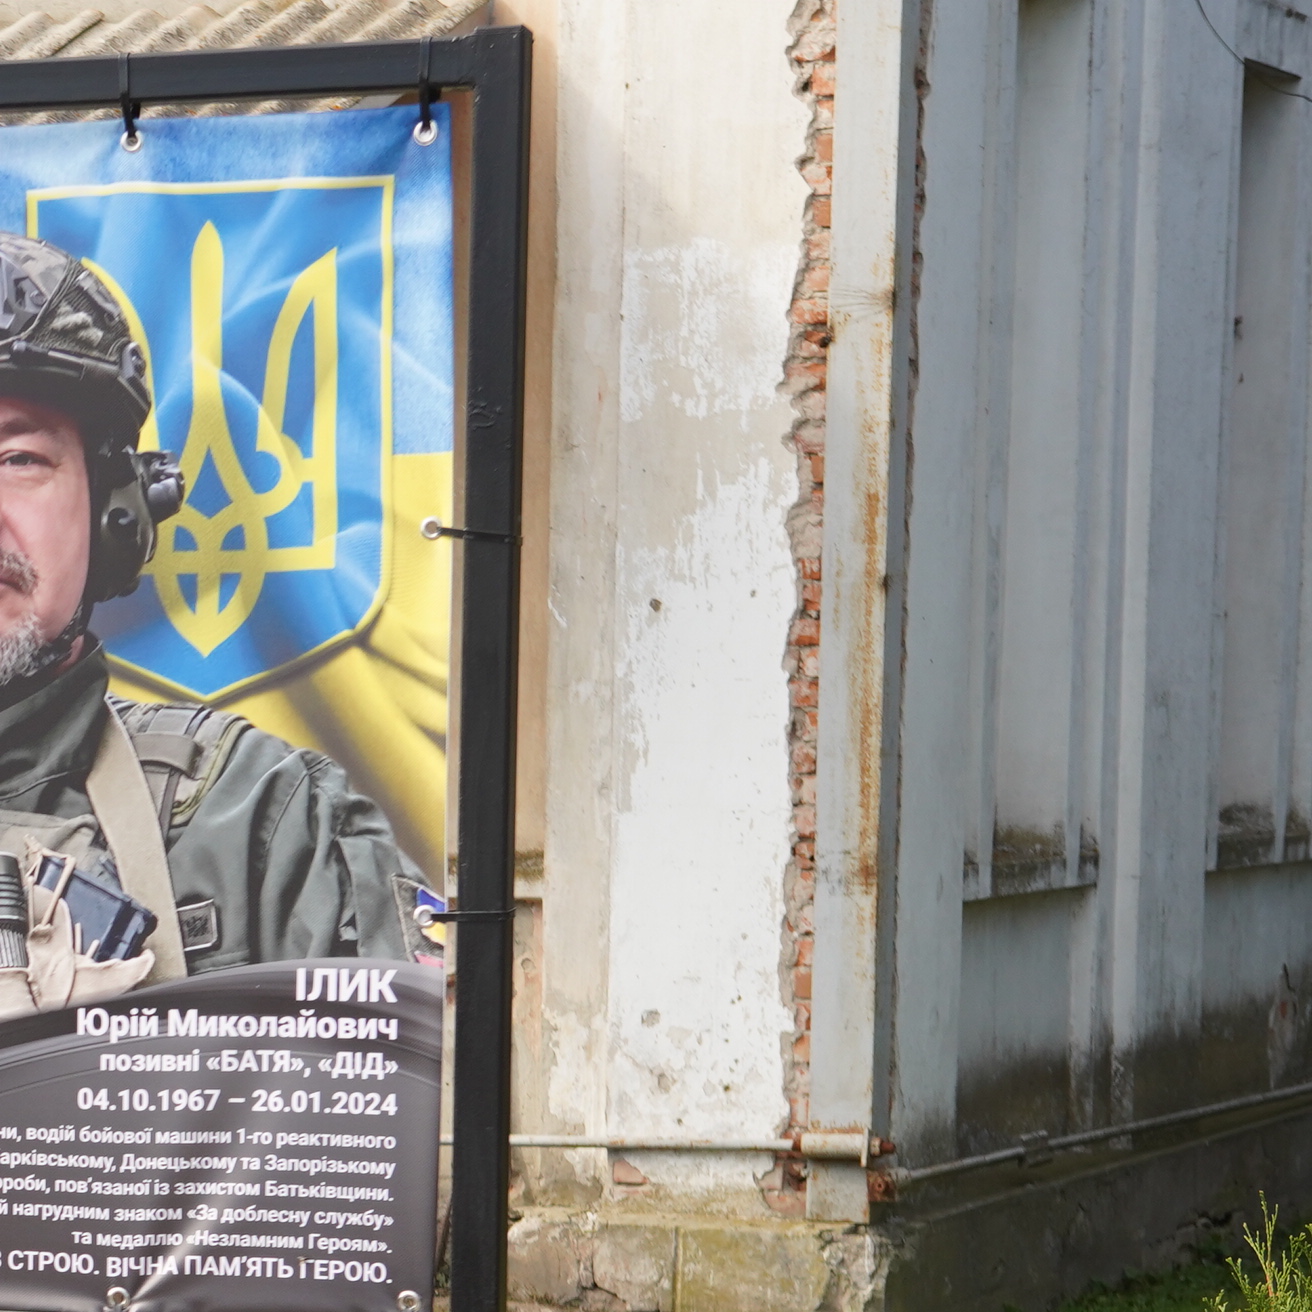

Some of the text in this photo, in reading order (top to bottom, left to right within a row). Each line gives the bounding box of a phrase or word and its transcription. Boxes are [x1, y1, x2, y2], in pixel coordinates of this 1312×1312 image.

[295, 967, 399, 1003] ІЛИК
[76, 1007, 398, 1043] Юрій Миколайович
[99, 1049, 399, 1080] позивні «БАТЯ», «ДІД»
[76, 1087, 221, 1112] 04.10.1967
[251, 1090, 398, 1115] 26.01.2024
[25, 1124, 76, 1143] водій
[78, 1126, 153, 1145] бойової
[154, 1131, 232, 1145] машини
[236, 1128, 273, 1147] 1-го
[275, 1132, 397, 1151] реактивного
[119, 1153, 238, 1173] Донецькому
[240, 1157, 262, 1171] та
[264, 1154, 396, 1178] Запорізькому
[53, 1176, 151, 1196] пов'язаної
[153, 1179, 171, 1196] із
[172, 1182, 261, 1197] захистом
[264, 1180, 394, 1203] Батьківщини.
[11, 1201, 111, 1221] нагрудним
[113, 1207, 183, 1221] знаком
[186, 1203, 219, 1220] «За
[220, 1205, 311, 1228] доблесну
[313, 1208, 394, 1231] службу»
[71, 1229, 393, 1255] та медаллю «Незламним Героям».
[7, 1250, 100, 1275] СТРОЮ.
[105, 1254, 179, 1277] ВІЧНА
[183, 1256, 294, 1279] ПАМ'ЯТЬ
[299, 1257, 393, 1284] ГЕРОЮ.
